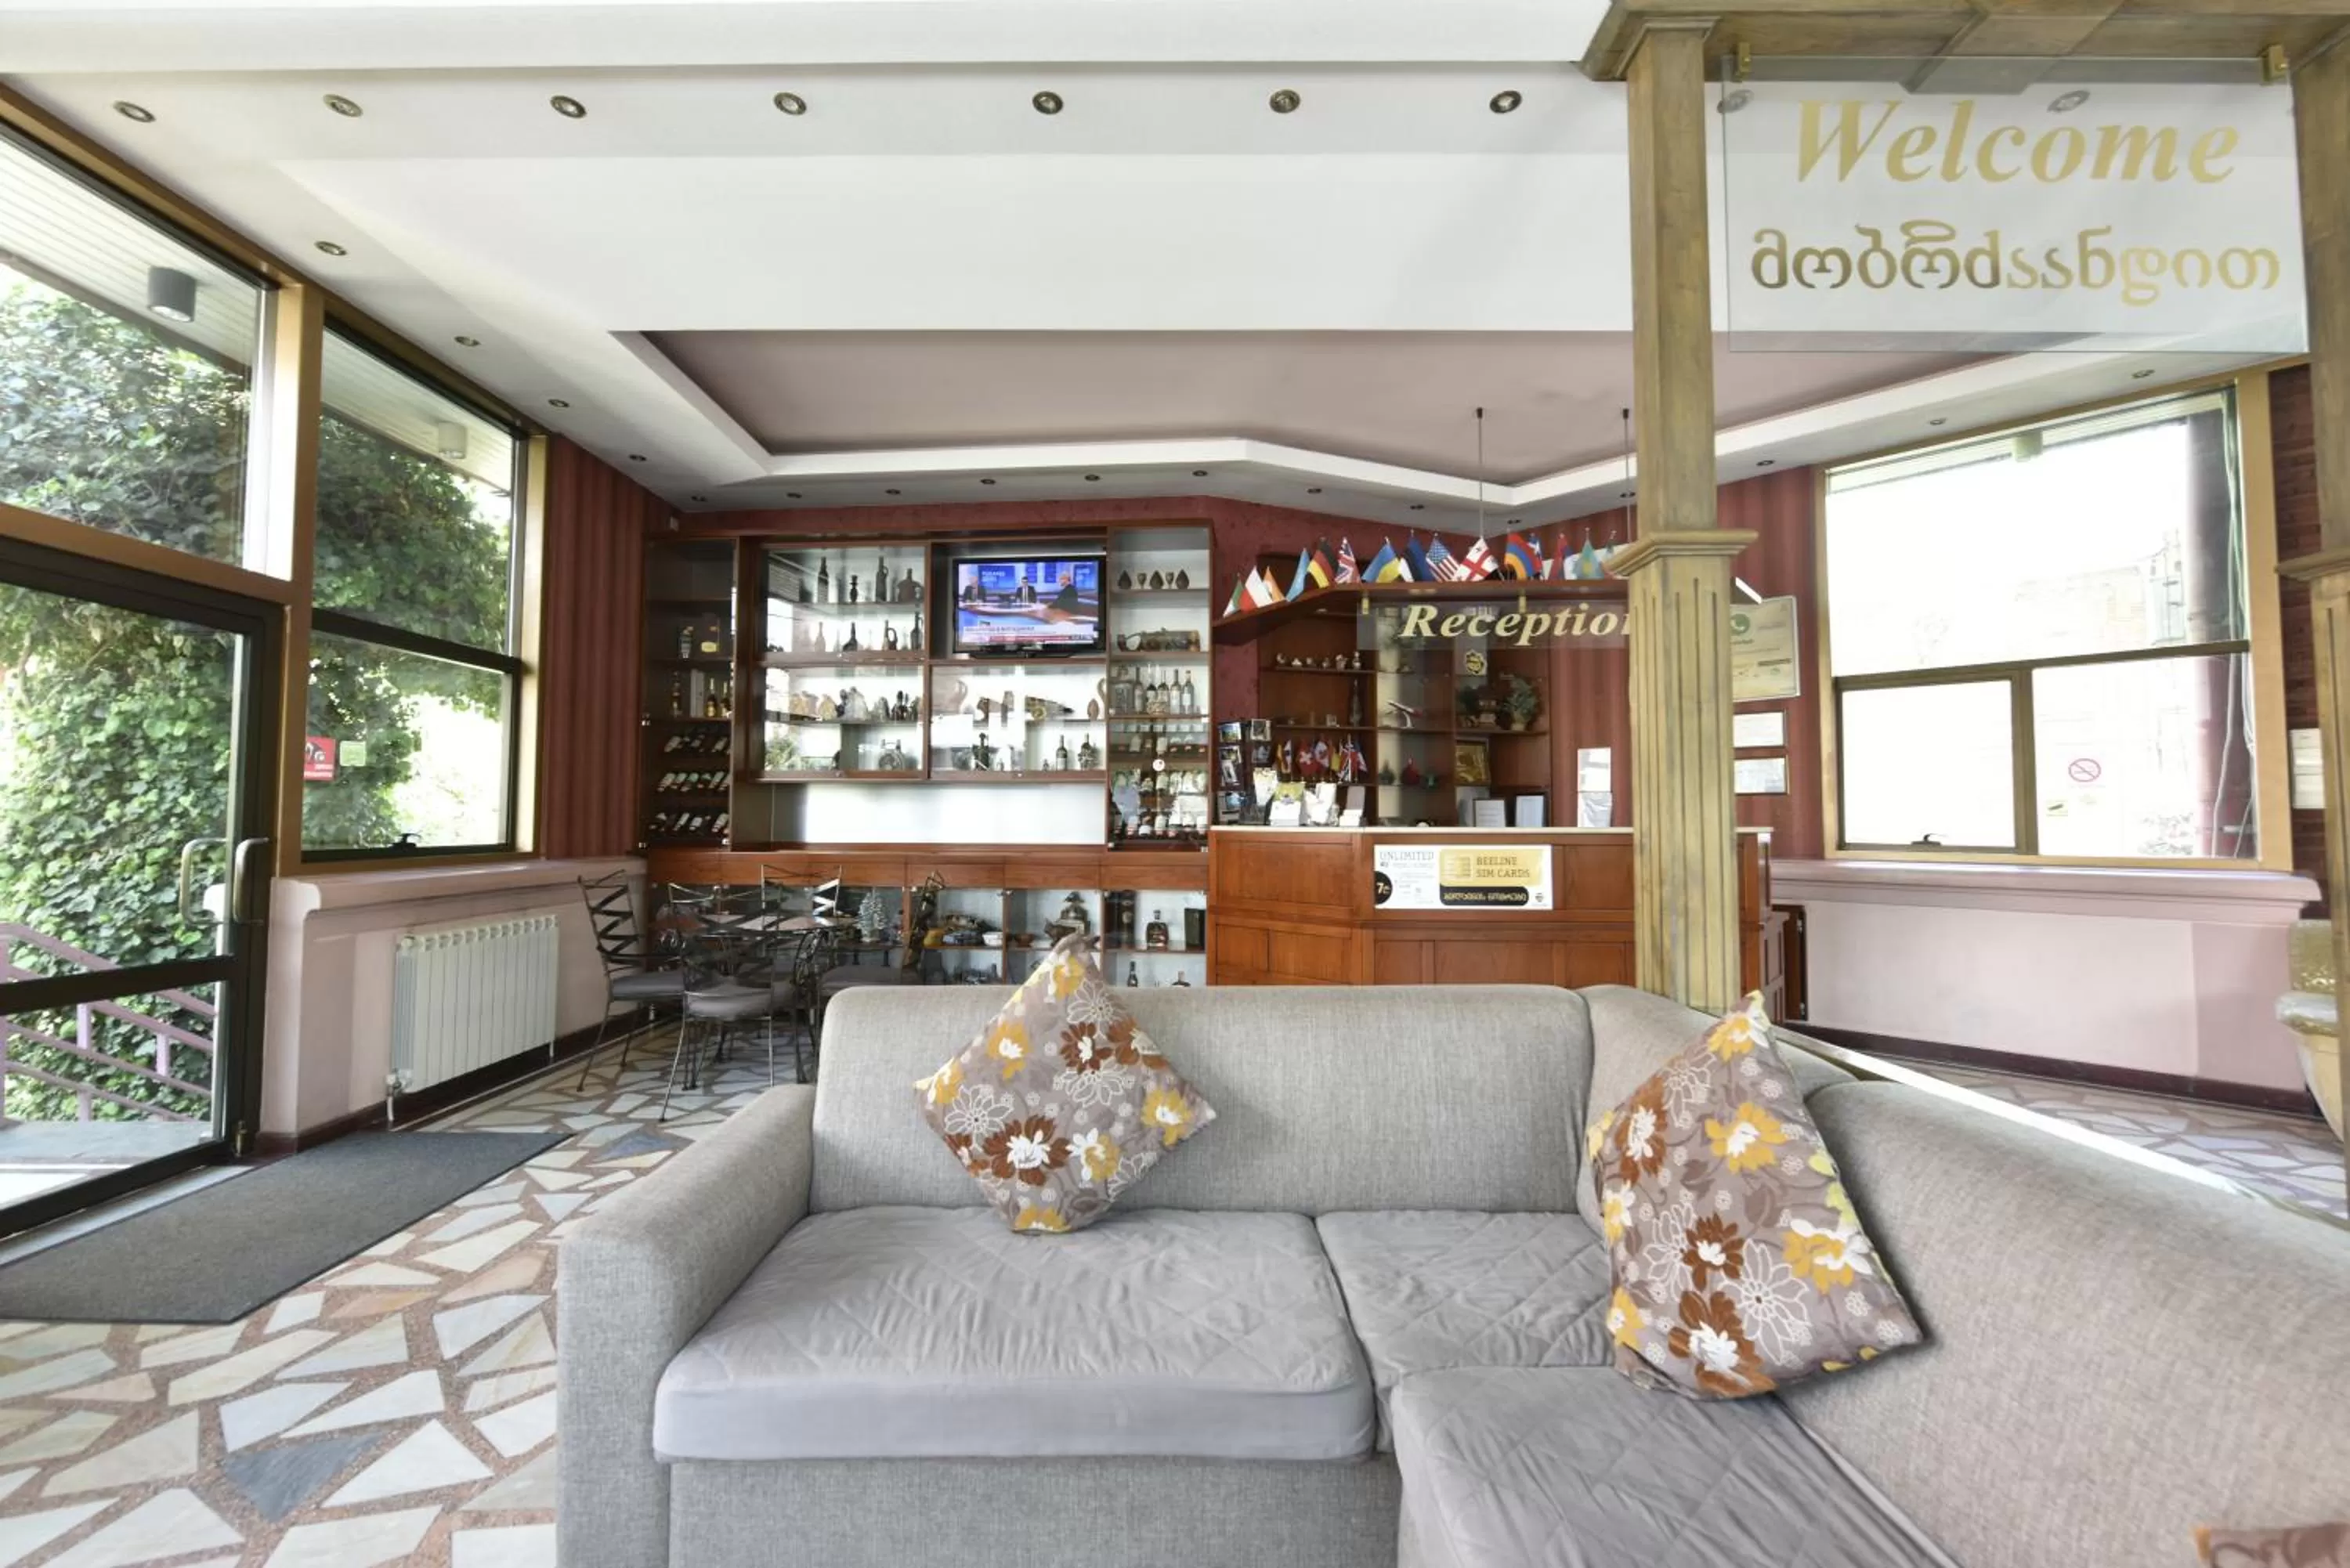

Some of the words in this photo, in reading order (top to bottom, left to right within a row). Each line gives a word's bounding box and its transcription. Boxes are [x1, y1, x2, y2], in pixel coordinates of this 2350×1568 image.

[1797, 99, 2240, 183] Welcome
[1477, 856, 1517, 866] BEELINE
[1476, 869, 1495, 879] SIM
[1498, 869, 1530, 879] CARDS
